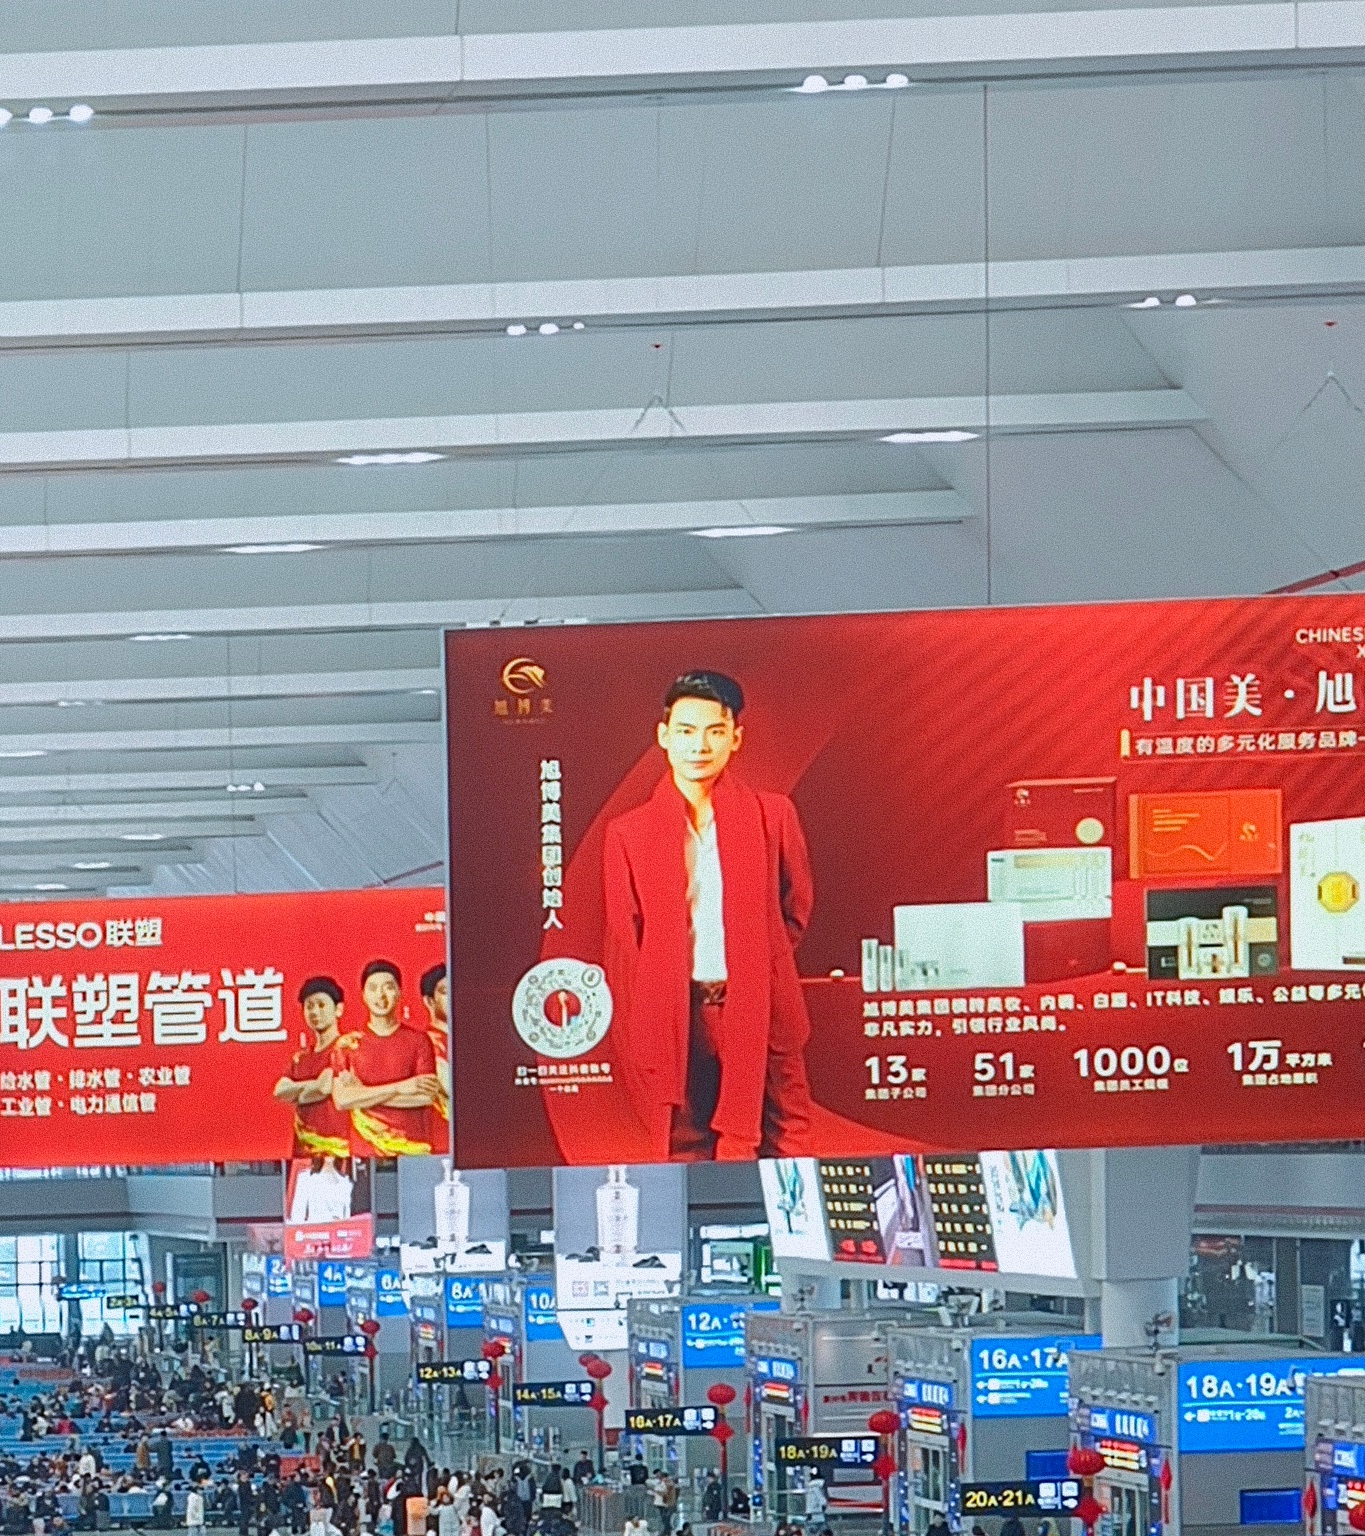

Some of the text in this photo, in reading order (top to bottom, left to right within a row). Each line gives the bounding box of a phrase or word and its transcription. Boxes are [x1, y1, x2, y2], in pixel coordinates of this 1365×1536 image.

[1295, 627, 1365, 644] CHINES
[106, 917, 163, 948] 联塑
[979, 1346, 1069, 1370] 16A·17A
[1186, 1372, 1291, 1399] 18A·19A
[779, 1444, 839, 1460] 18A·19A
[965, 1489, 1036, 1508] 20A·21A
